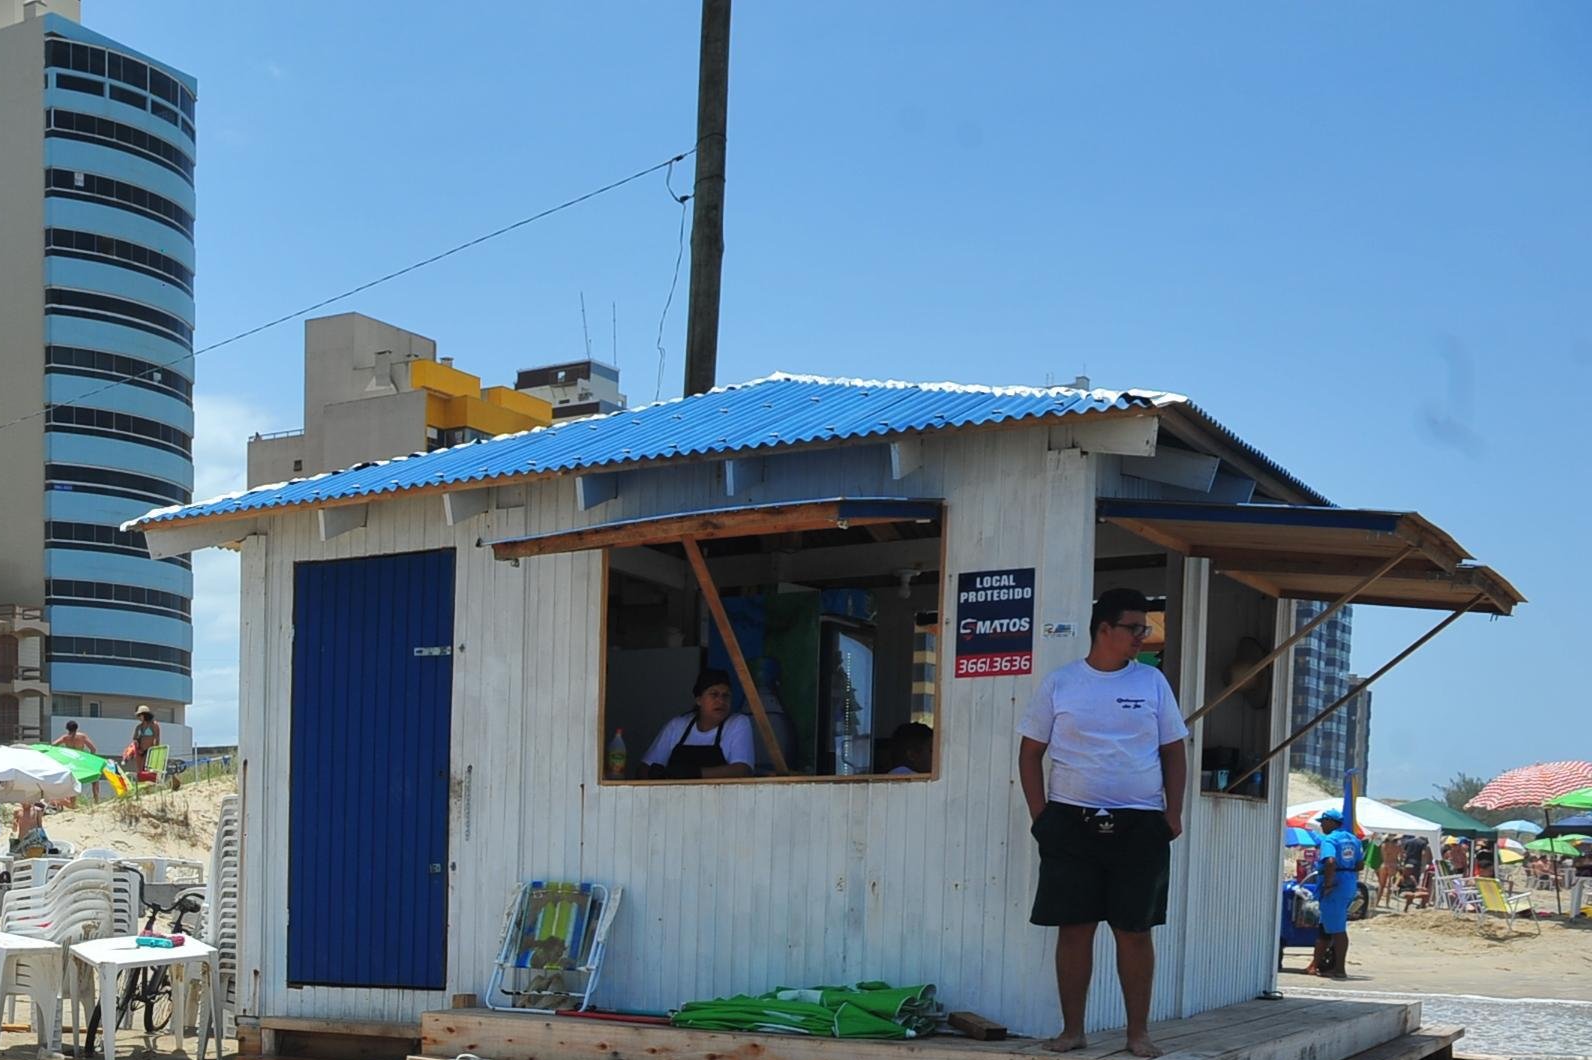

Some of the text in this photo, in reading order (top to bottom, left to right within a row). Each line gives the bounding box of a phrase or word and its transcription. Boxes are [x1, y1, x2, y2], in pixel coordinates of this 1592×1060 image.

[976, 574, 1016, 588] LOCAL
[959, 587, 1032, 603] PROTEGIDO
[976, 617, 1030, 635] MATOS
[958, 655, 1031, 674] 3661.3636
